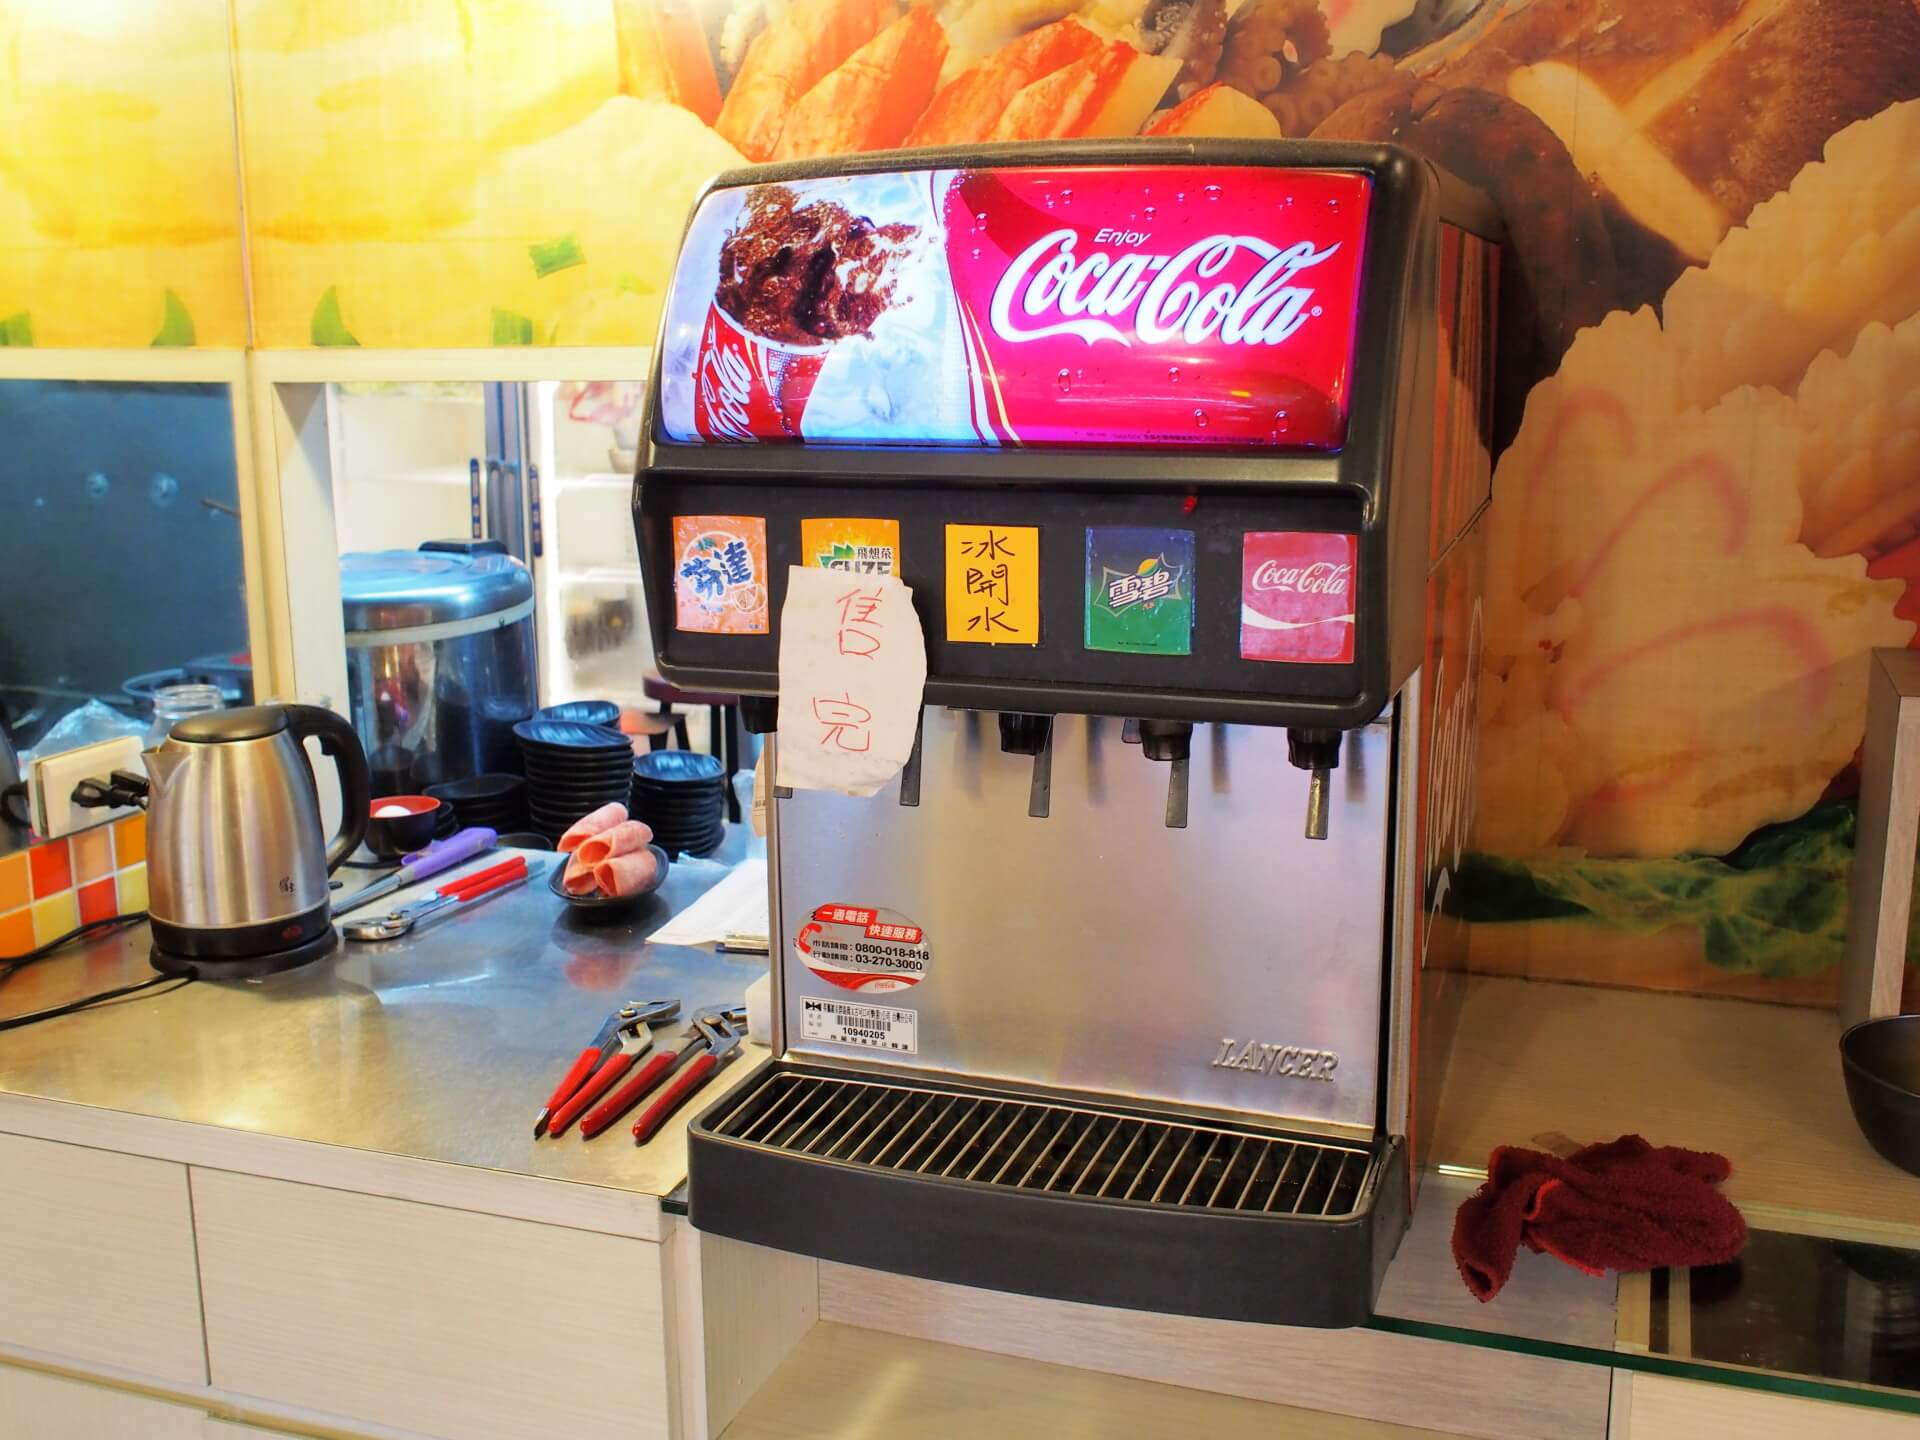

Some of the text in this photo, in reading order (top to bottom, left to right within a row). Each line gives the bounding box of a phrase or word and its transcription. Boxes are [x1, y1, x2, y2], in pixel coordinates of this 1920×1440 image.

[1093, 227, 1152, 247] Enjoy
[989, 228, 1342, 348] Coca-Cola
[680, 540, 752, 601] 芬達
[961, 529, 1019, 632] 冰開水
[1109, 569, 1173, 608] 雪碧
[1252, 559, 1352, 595] Coca-Cola
[813, 586, 883, 752] 售完
[821, 908, 870, 924] 一通電話
[868, 924, 918, 941] 快速服務
[855, 943, 929, 960] 0800-018-818
[855, 954, 923, 970] 03-270-3000
[843, 1027, 886, 1040] 10940205
[1211, 1038, 1339, 1082] LANCER
